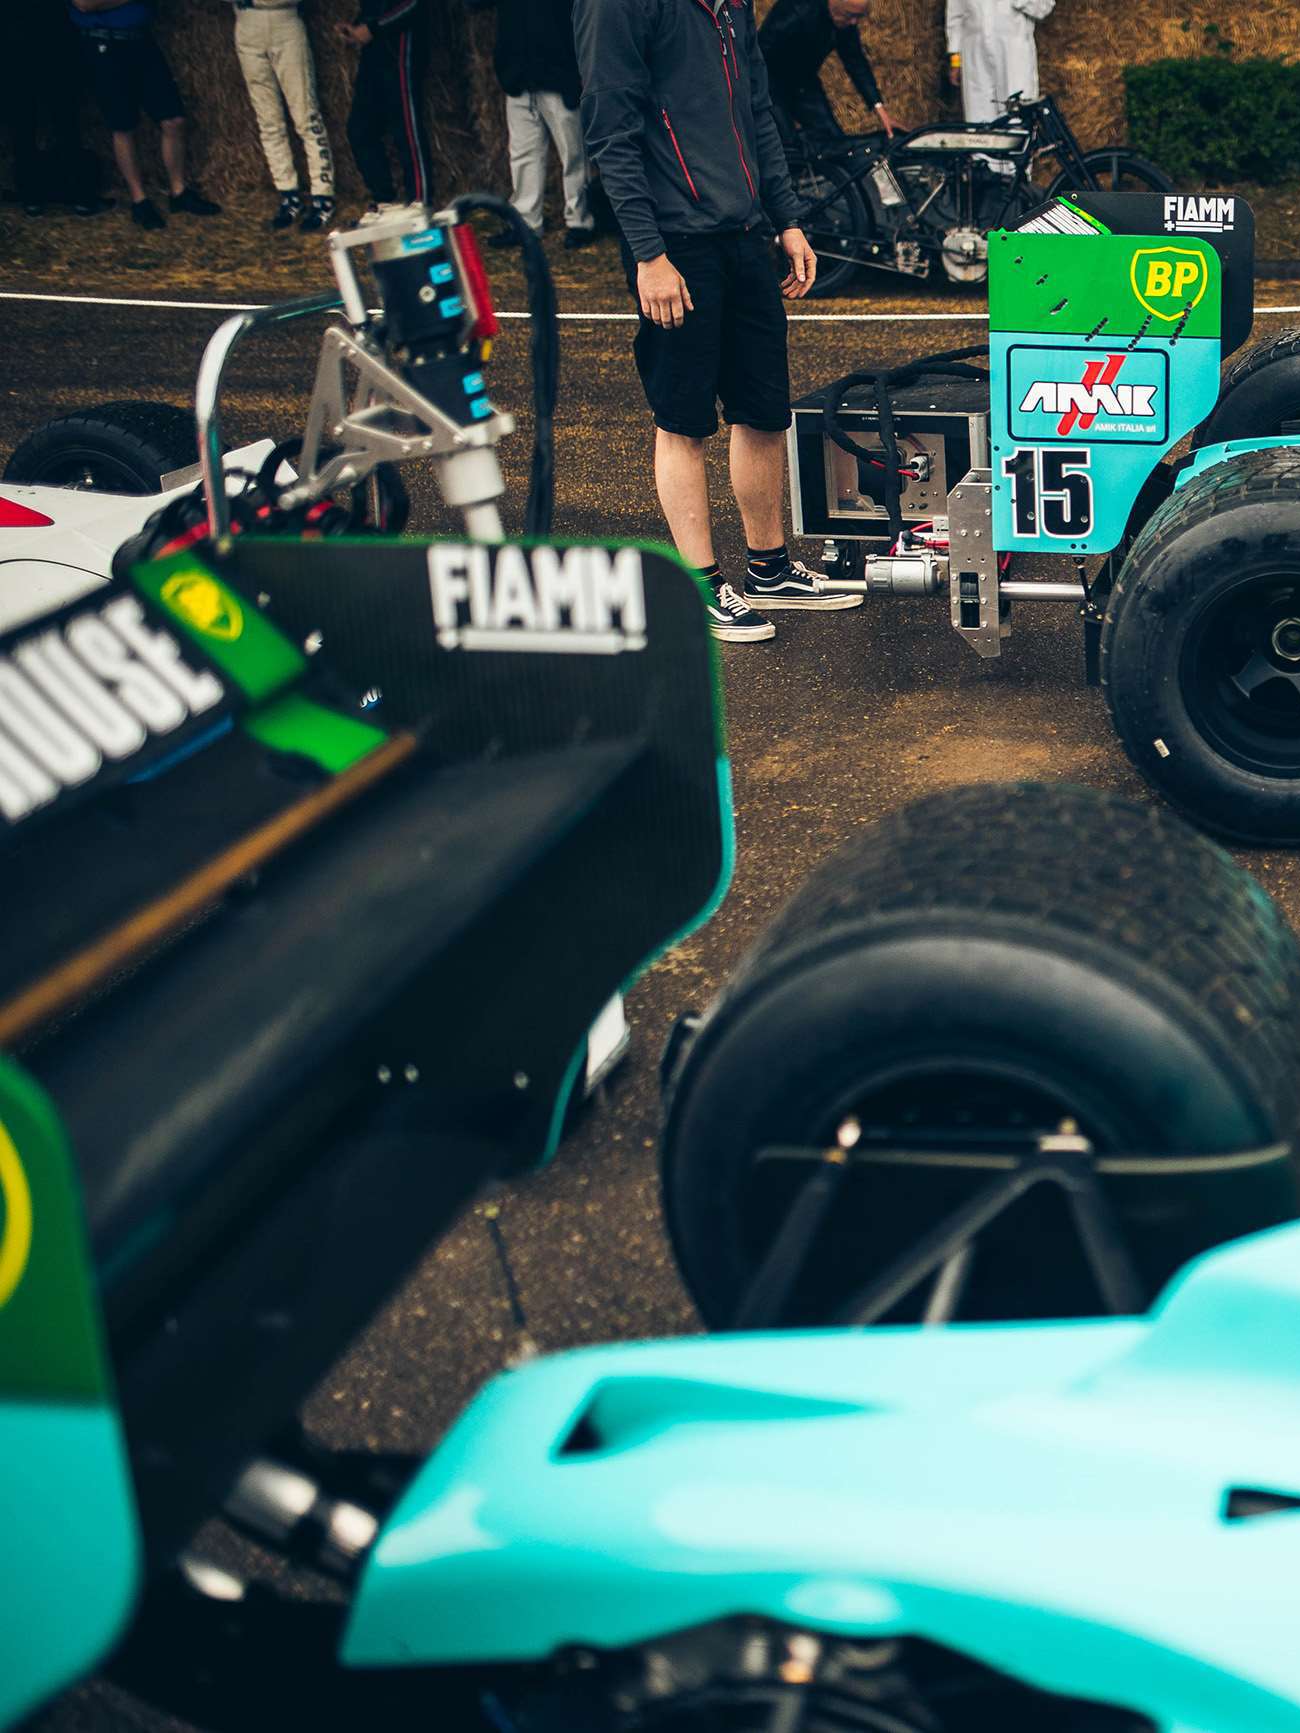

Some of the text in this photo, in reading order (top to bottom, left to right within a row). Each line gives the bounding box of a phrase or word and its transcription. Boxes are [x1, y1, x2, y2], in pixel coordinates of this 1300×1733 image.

[1164, 196, 1235, 222] FIAMM
[1143, 260, 1199, 297] BP
[1019, 380, 1158, 416] AMIK
[1095, 423, 1117, 432] AMIK
[1118, 423, 1145, 433] ITALIA
[1002, 448, 1093, 538] 15
[427, 544, 647, 631] FIAMM
